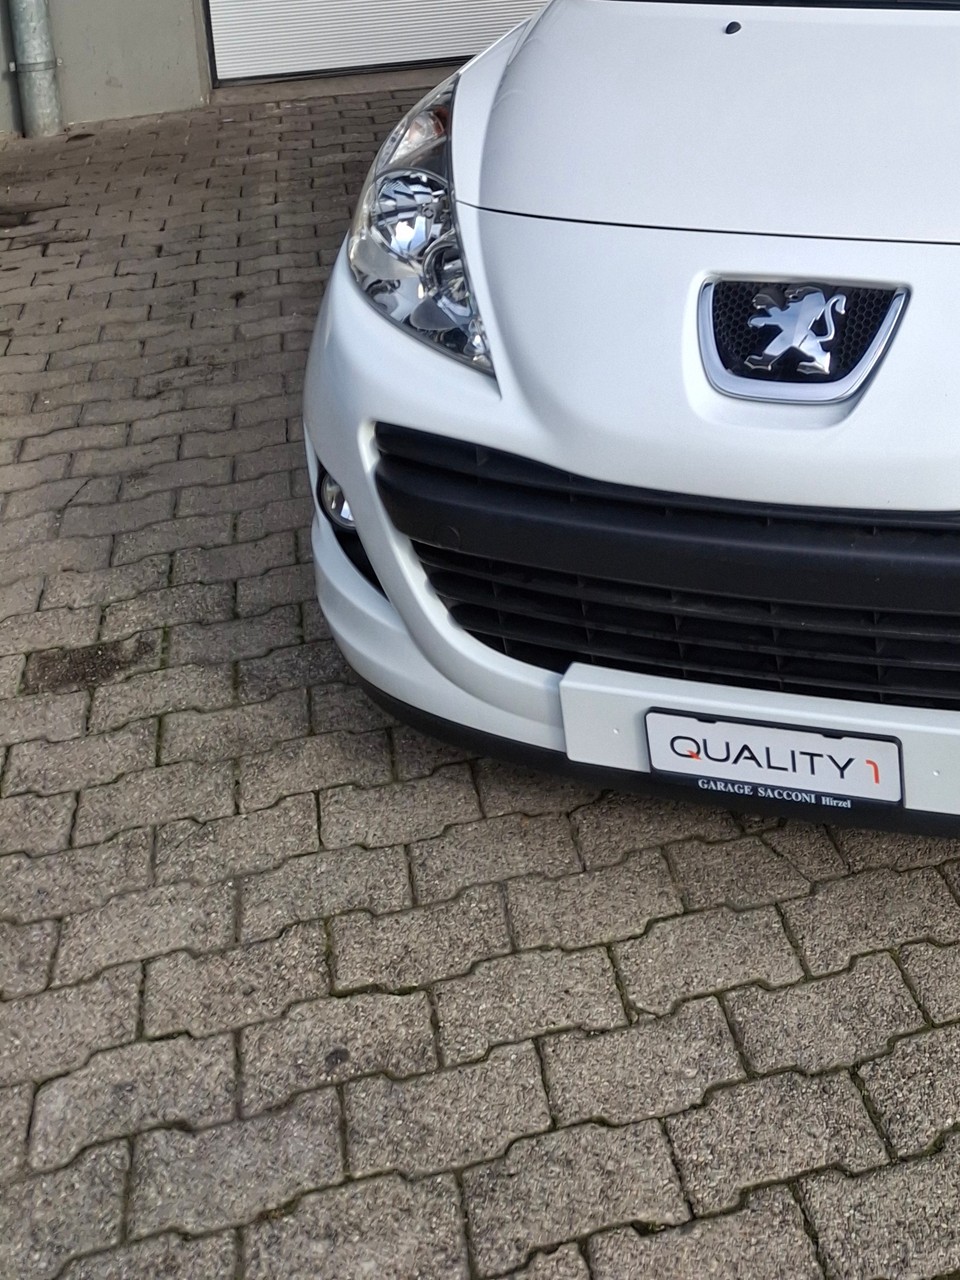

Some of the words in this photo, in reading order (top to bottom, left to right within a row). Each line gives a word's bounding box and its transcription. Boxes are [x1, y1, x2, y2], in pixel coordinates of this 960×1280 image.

[698, 778, 753, 795] GARAGE
[757, 786, 816, 804] SACCONI
[821, 796, 852, 809] Hirzel
